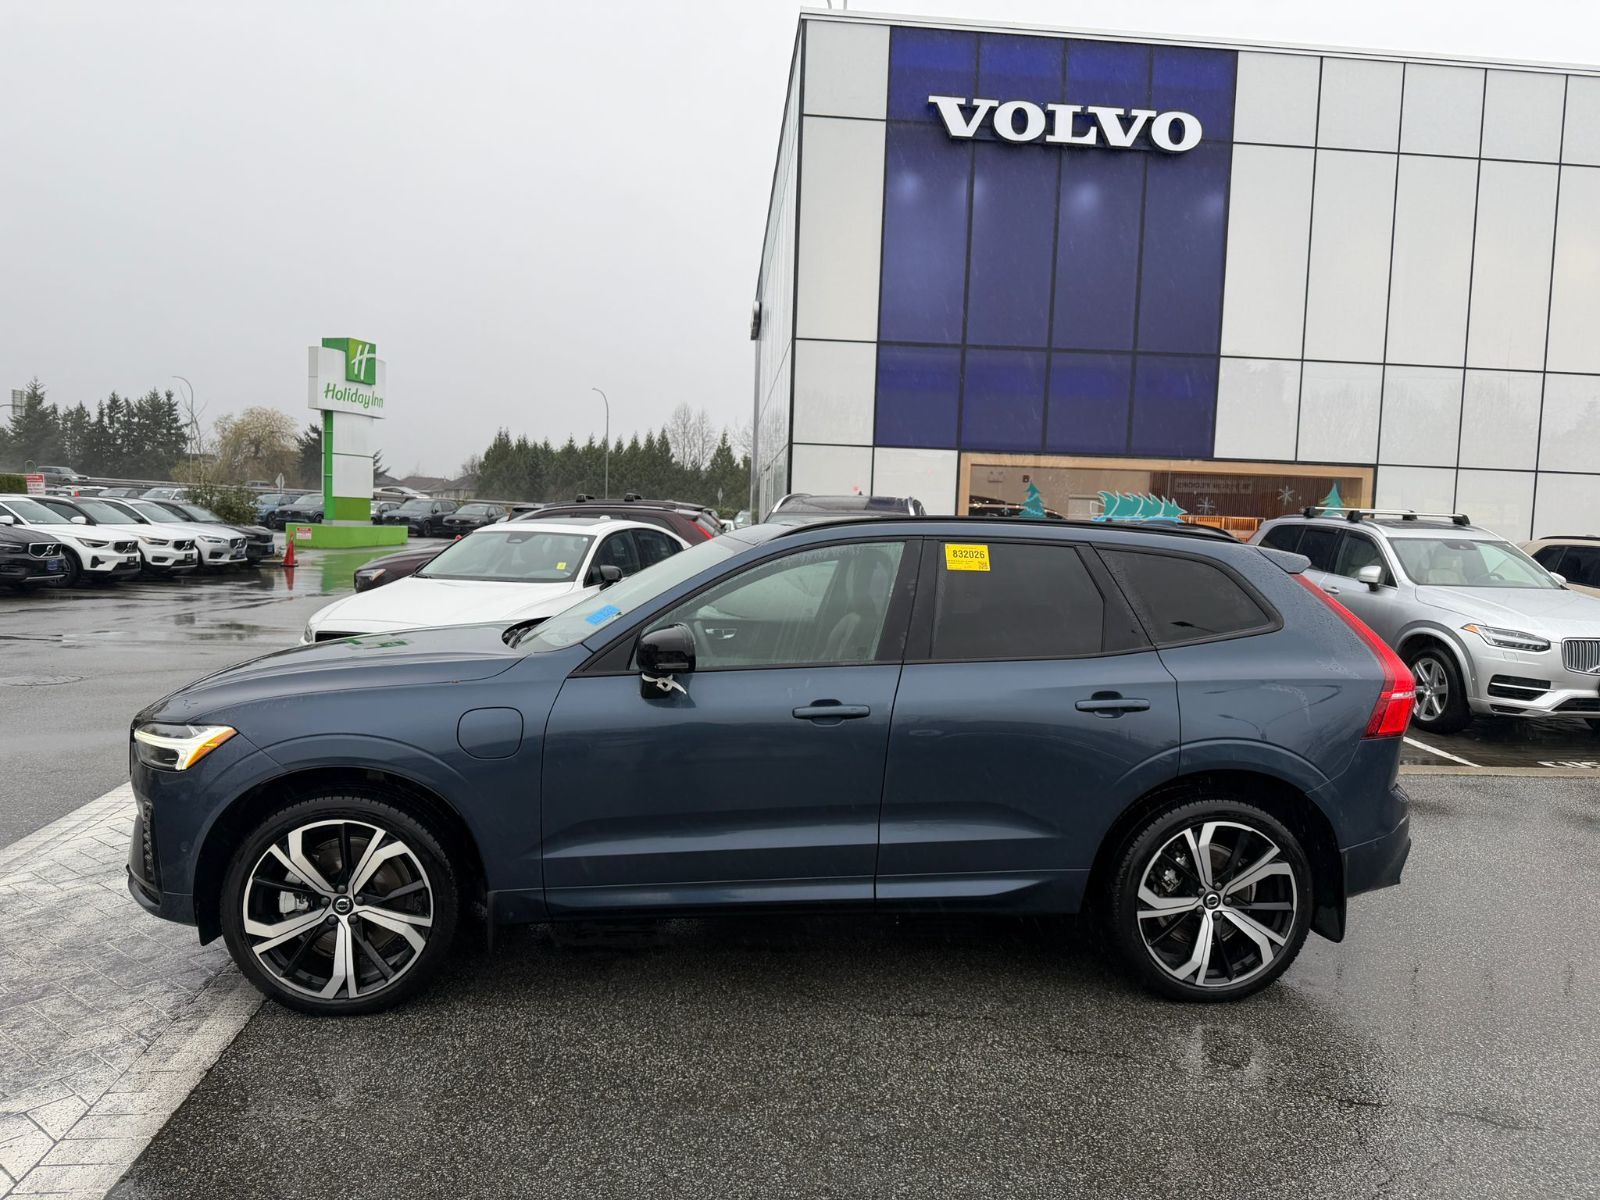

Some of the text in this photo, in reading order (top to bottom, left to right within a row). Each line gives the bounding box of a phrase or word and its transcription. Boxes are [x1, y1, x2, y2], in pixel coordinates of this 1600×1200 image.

[928, 95, 1203, 152] VOLVO
[324, 383, 384, 409] Holiday Inn
[952, 549, 985, 559] 832026
